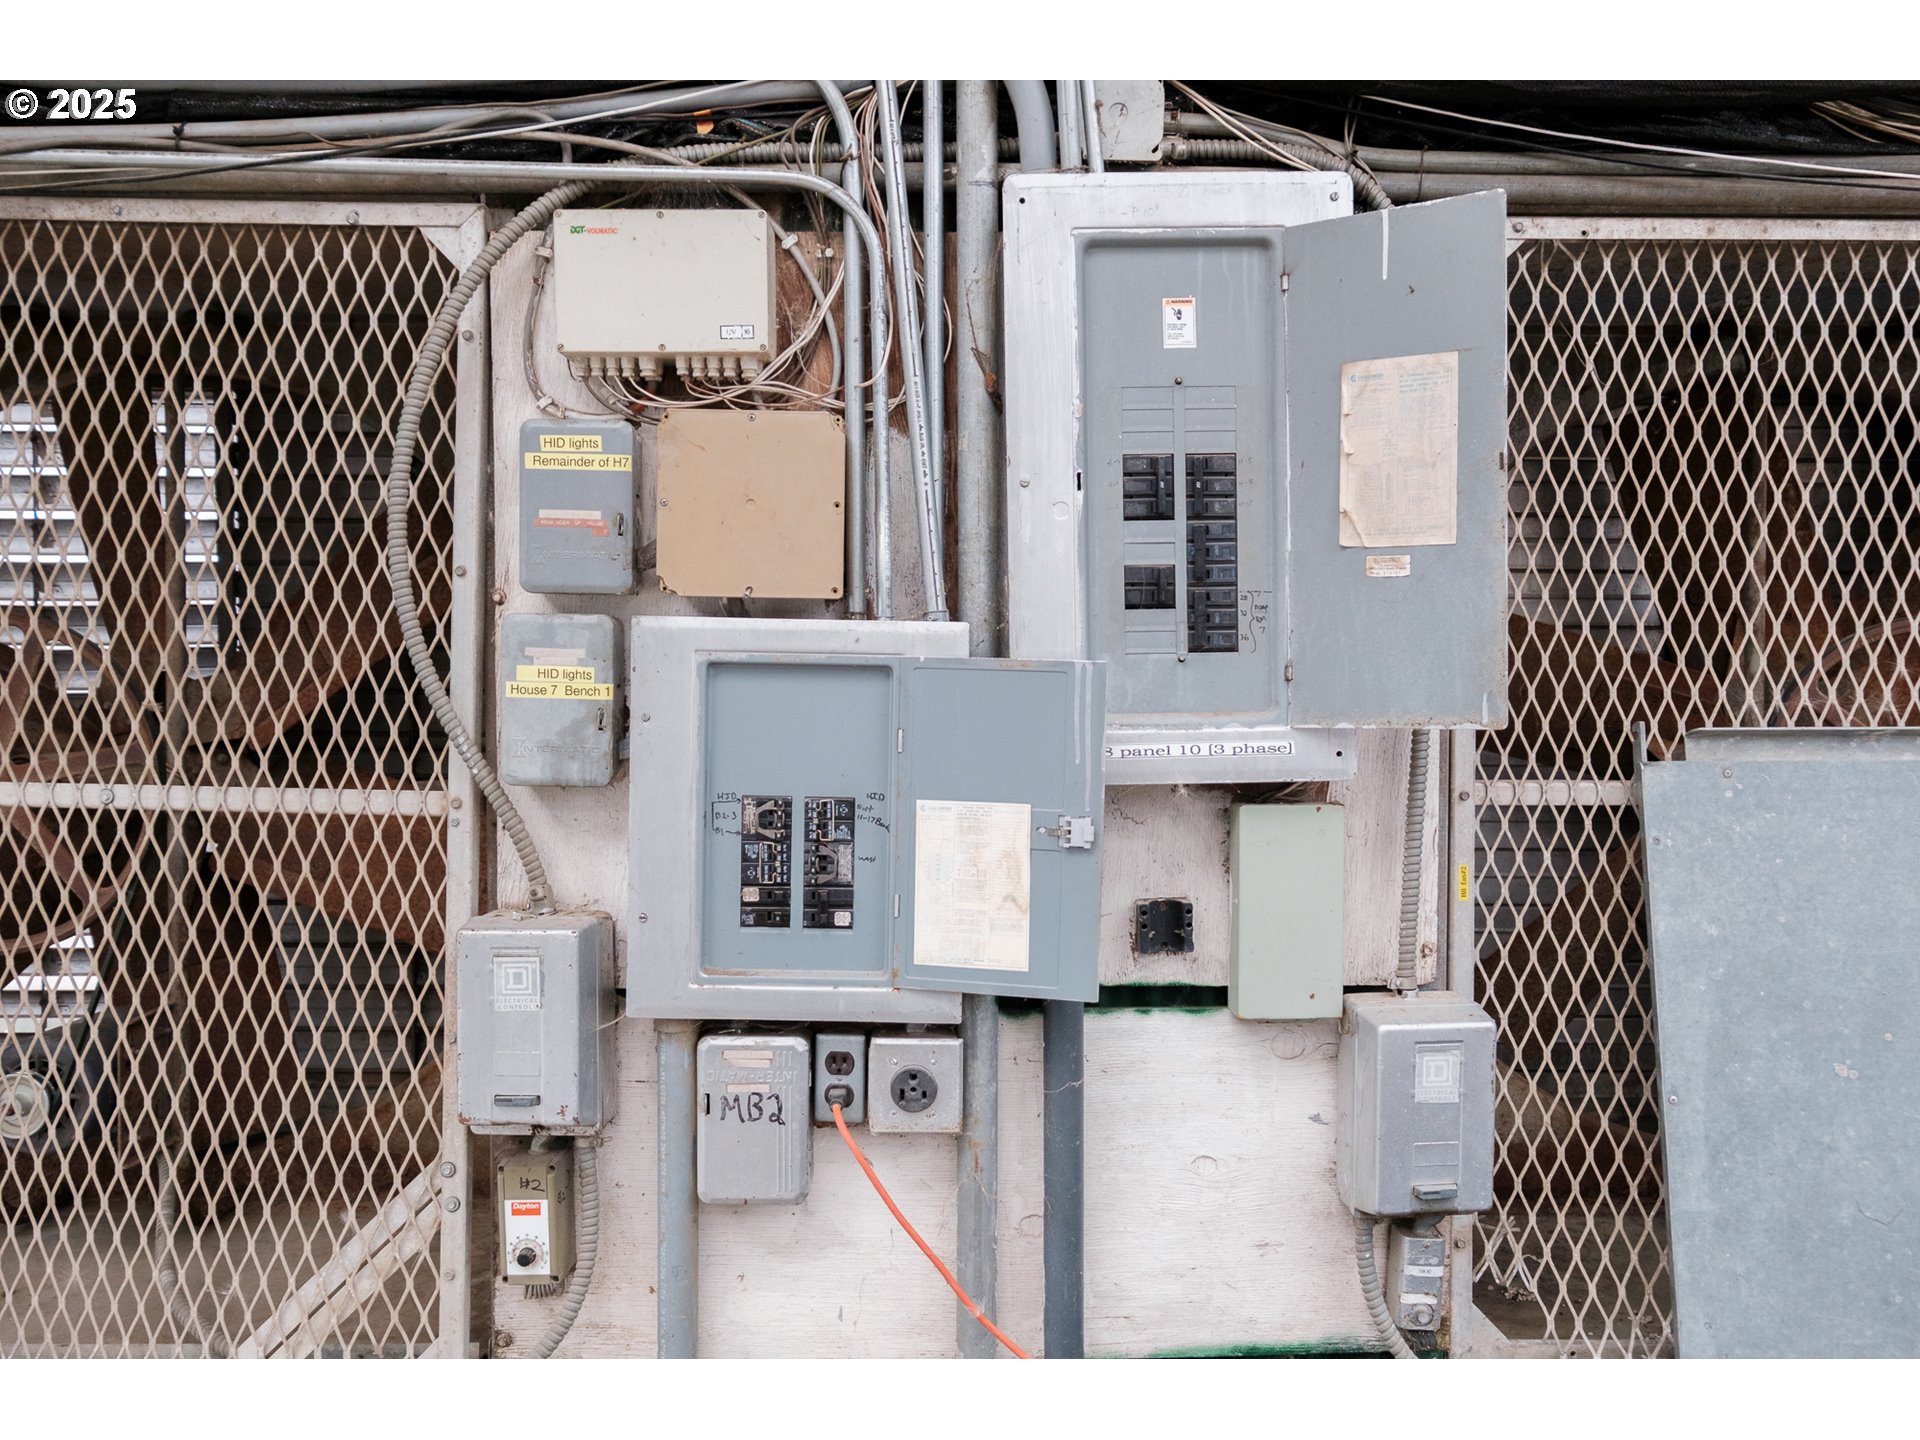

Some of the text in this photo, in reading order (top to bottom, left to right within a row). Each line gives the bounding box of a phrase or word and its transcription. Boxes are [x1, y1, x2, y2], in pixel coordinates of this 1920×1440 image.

[543, 437, 599, 451] HID lights
[532, 455, 630, 468] Remainder of H7
[537, 668, 593, 682] HID lights
[510, 684, 610, 697] House 7 Bench 1
[1116, 745, 1170, 759] panel
[1180, 744, 1201, 756] 10
[512, 1203, 540, 1211] Dayton
